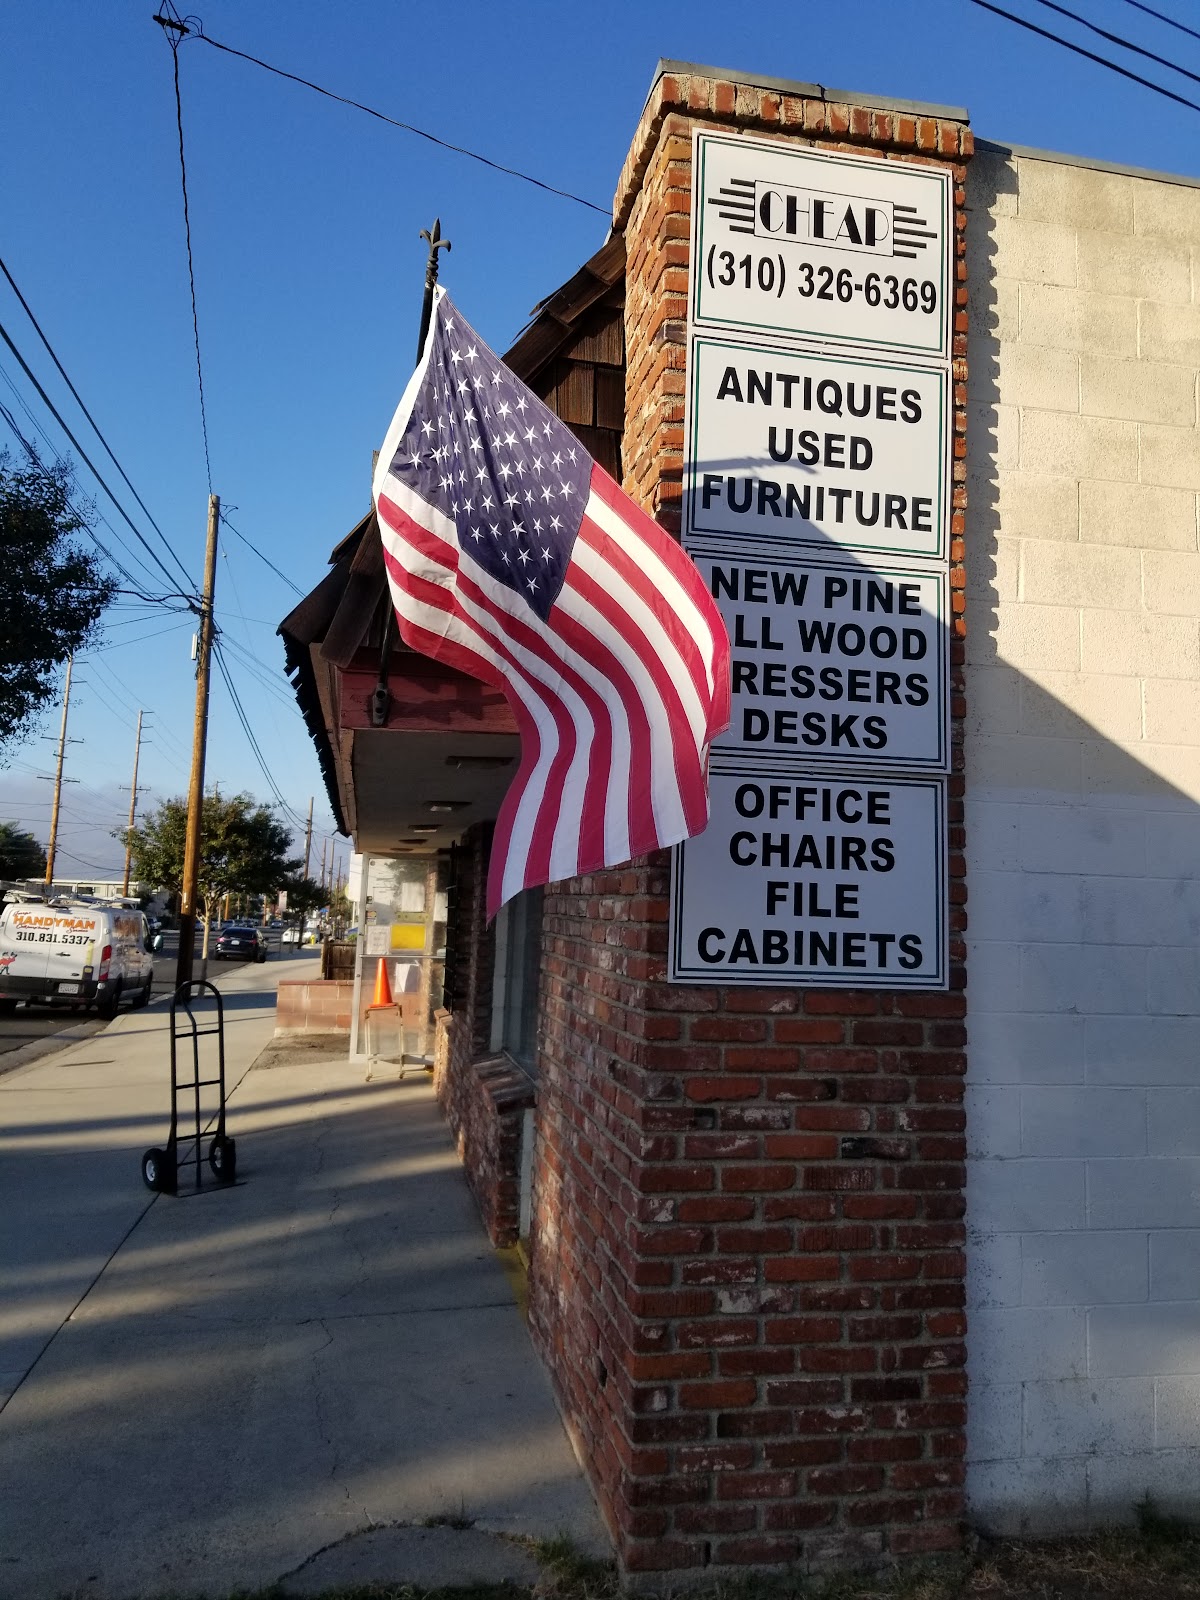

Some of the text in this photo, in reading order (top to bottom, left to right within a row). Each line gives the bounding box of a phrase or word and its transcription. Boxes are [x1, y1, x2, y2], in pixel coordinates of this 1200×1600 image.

[759, 190, 889, 248] CHEAP
[707, 244, 937, 314] (310) 326-6369
[717, 366, 922, 424] ANTIQUES
[767, 426, 873, 471] USED
[701, 474, 932, 532] FURNITURE
[711, 566, 921, 616] NEW PINE
[720, 613, 927, 660] LL WOOD
[731, 660, 930, 706] RESSERS
[742, 707, 887, 749] DESKS
[734, 783, 891, 825] OFFICE
[729, 830, 895, 873] CHAIRS
[13, 915, 95, 929] HANDYMAN
[766, 881, 859, 919] FILE
[16, 931, 90, 945] 310.831.5337
[697, 927, 923, 970] CABINETS
